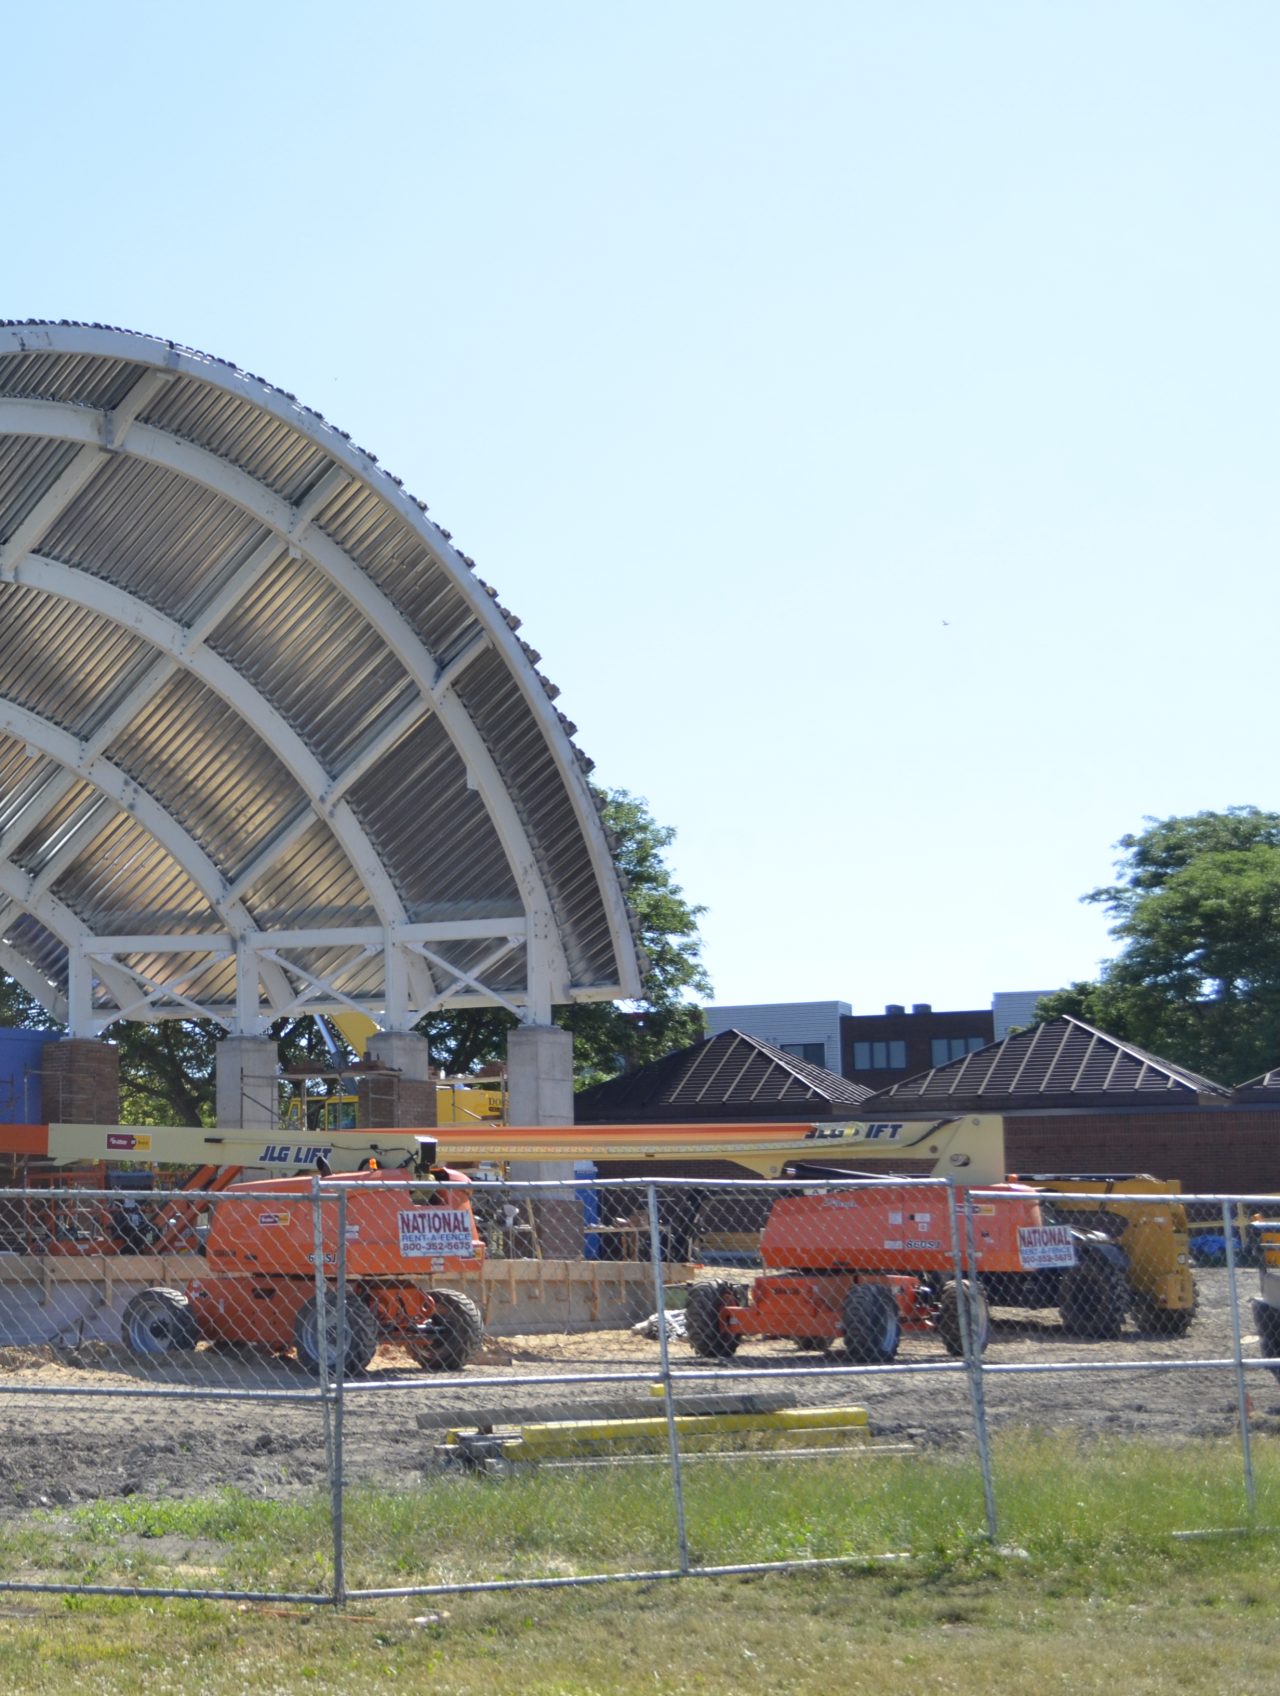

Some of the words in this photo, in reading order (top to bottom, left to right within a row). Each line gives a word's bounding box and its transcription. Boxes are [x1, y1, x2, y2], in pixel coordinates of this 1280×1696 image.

[259, 1146, 290, 1162] JLG
[293, 1147, 332, 1163] LIFT
[400, 1212, 469, 1233] NATIONAL
[401, 1233, 470, 1242] RENT-A-FENCE
[1019, 1227, 1071, 1247] NATIONAL
[403, 1242, 470, 1251] 800-352-5675
